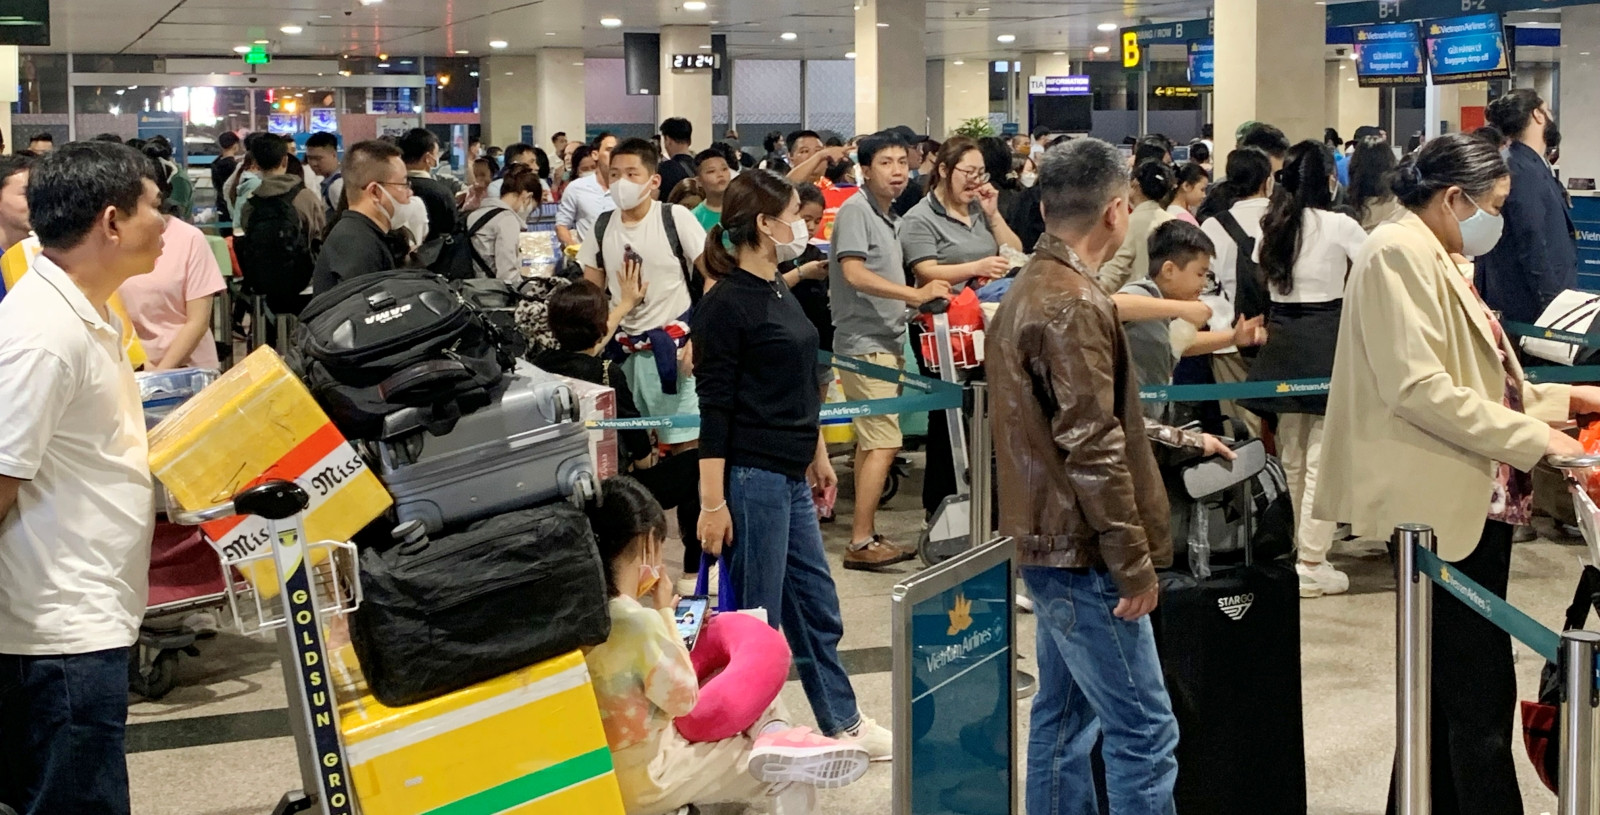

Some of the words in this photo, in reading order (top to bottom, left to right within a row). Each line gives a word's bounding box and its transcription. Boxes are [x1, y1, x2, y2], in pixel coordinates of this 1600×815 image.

[1379, 2, 1400, 18] B-1
[1175, 23, 1183, 38] B
[1123, 32, 1140, 67] B
[1031, 81, 1044, 89] TIA
[311, 455, 363, 496] Miss
[222, 527, 269, 559] Mis
[1217, 592, 1255, 608] STARGO
[292, 590, 331, 727] GOLDSUN
[323, 752, 348, 815] GRO
